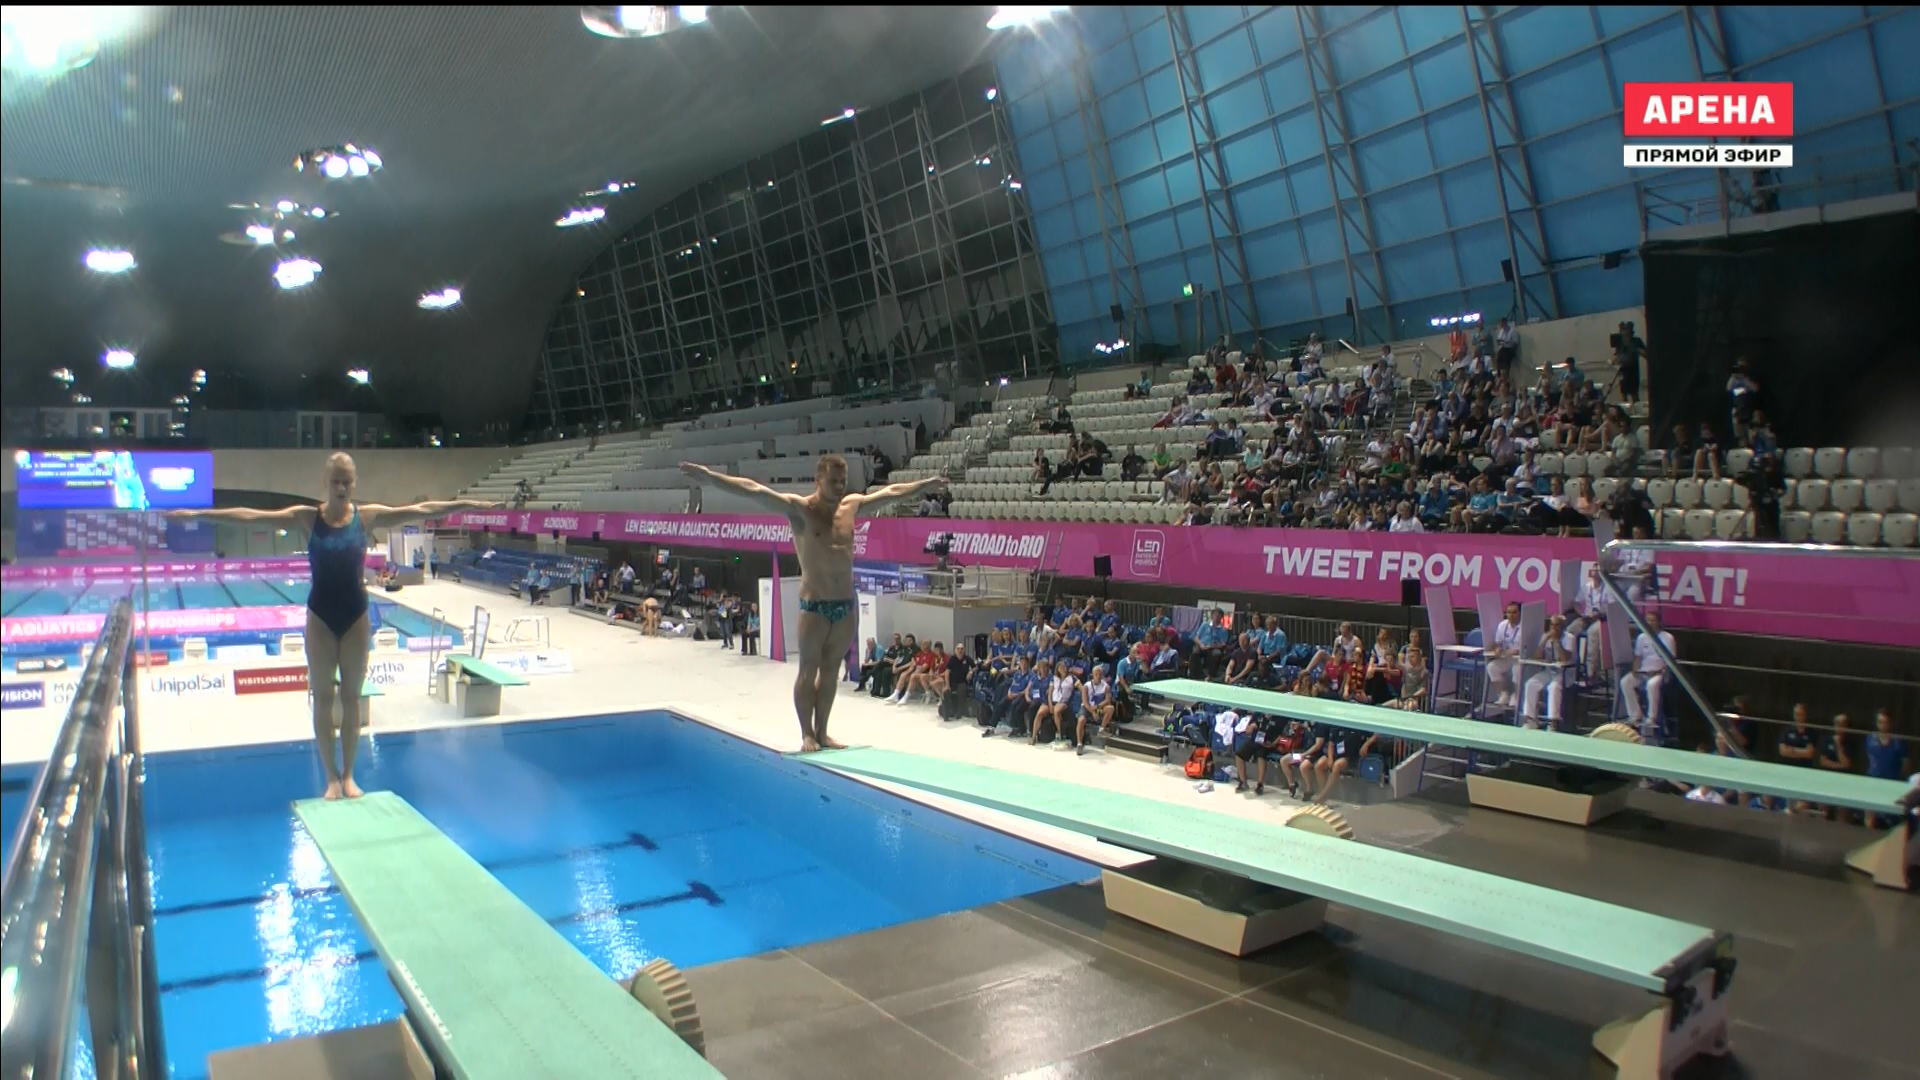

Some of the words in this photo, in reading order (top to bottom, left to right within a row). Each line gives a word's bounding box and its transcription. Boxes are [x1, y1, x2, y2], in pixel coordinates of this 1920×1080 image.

[625, 519, 639, 532] LEN
[639, 520, 678, 535] EUROPEAN
[678, 522, 722, 538] AQUATICS
[721, 525, 794, 542] CHAMPIONSHIP
[1263, 546, 1373, 580] TWEET
[1378, 551, 1482, 587] FROM
[1656, 563, 1748, 607] EAT!
[10, 620, 97, 637] AQUATICS
[368, 661, 405, 678] yrtha
[151, 672, 226, 697] UnipolSai
[238, 673, 309, 686] VISITLONDON.C
[367, 673, 395, 685] ools
